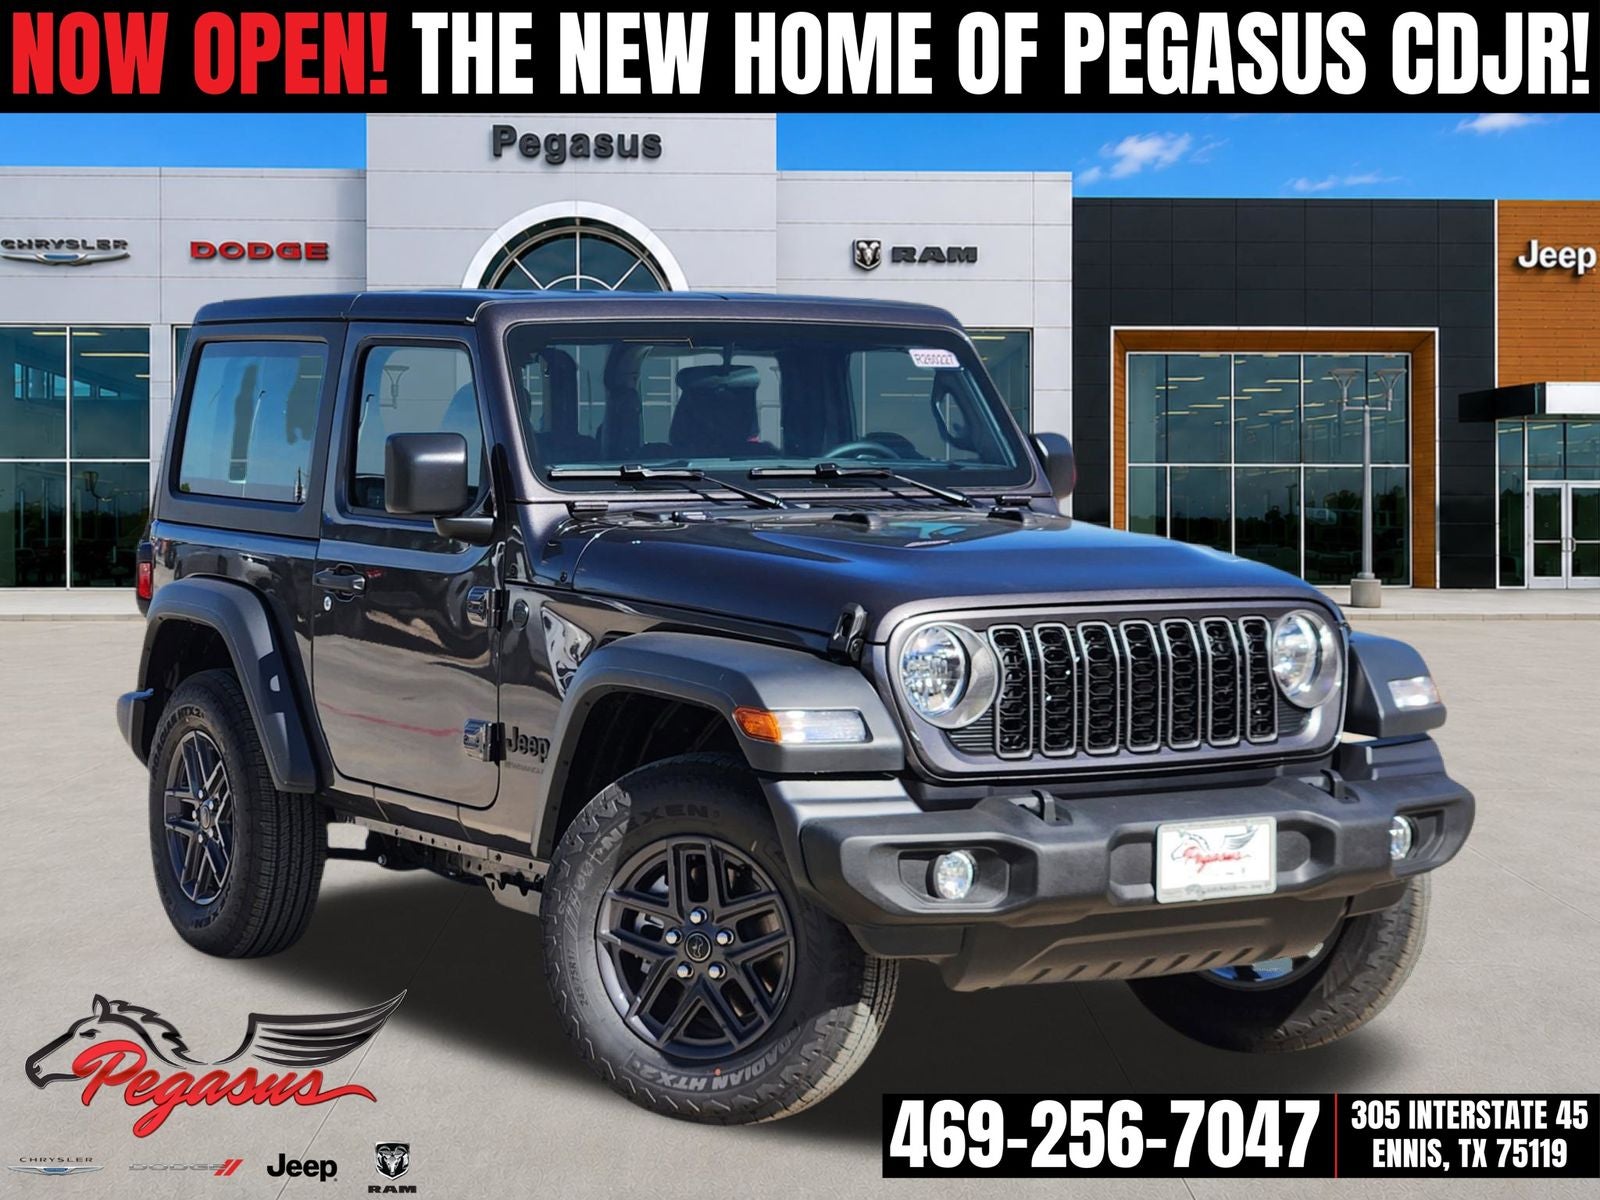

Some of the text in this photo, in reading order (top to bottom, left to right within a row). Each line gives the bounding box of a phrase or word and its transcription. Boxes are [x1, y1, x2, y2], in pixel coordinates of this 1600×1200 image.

[491, 124, 663, 166] Pegasus
[0, 238, 129, 251] CHRYSLER
[190, 241, 329, 260] DODGE
[891, 246, 978, 264] RAM
[1518, 239, 1597, 276] Jeep
[506, 726, 550, 763] Jeep
